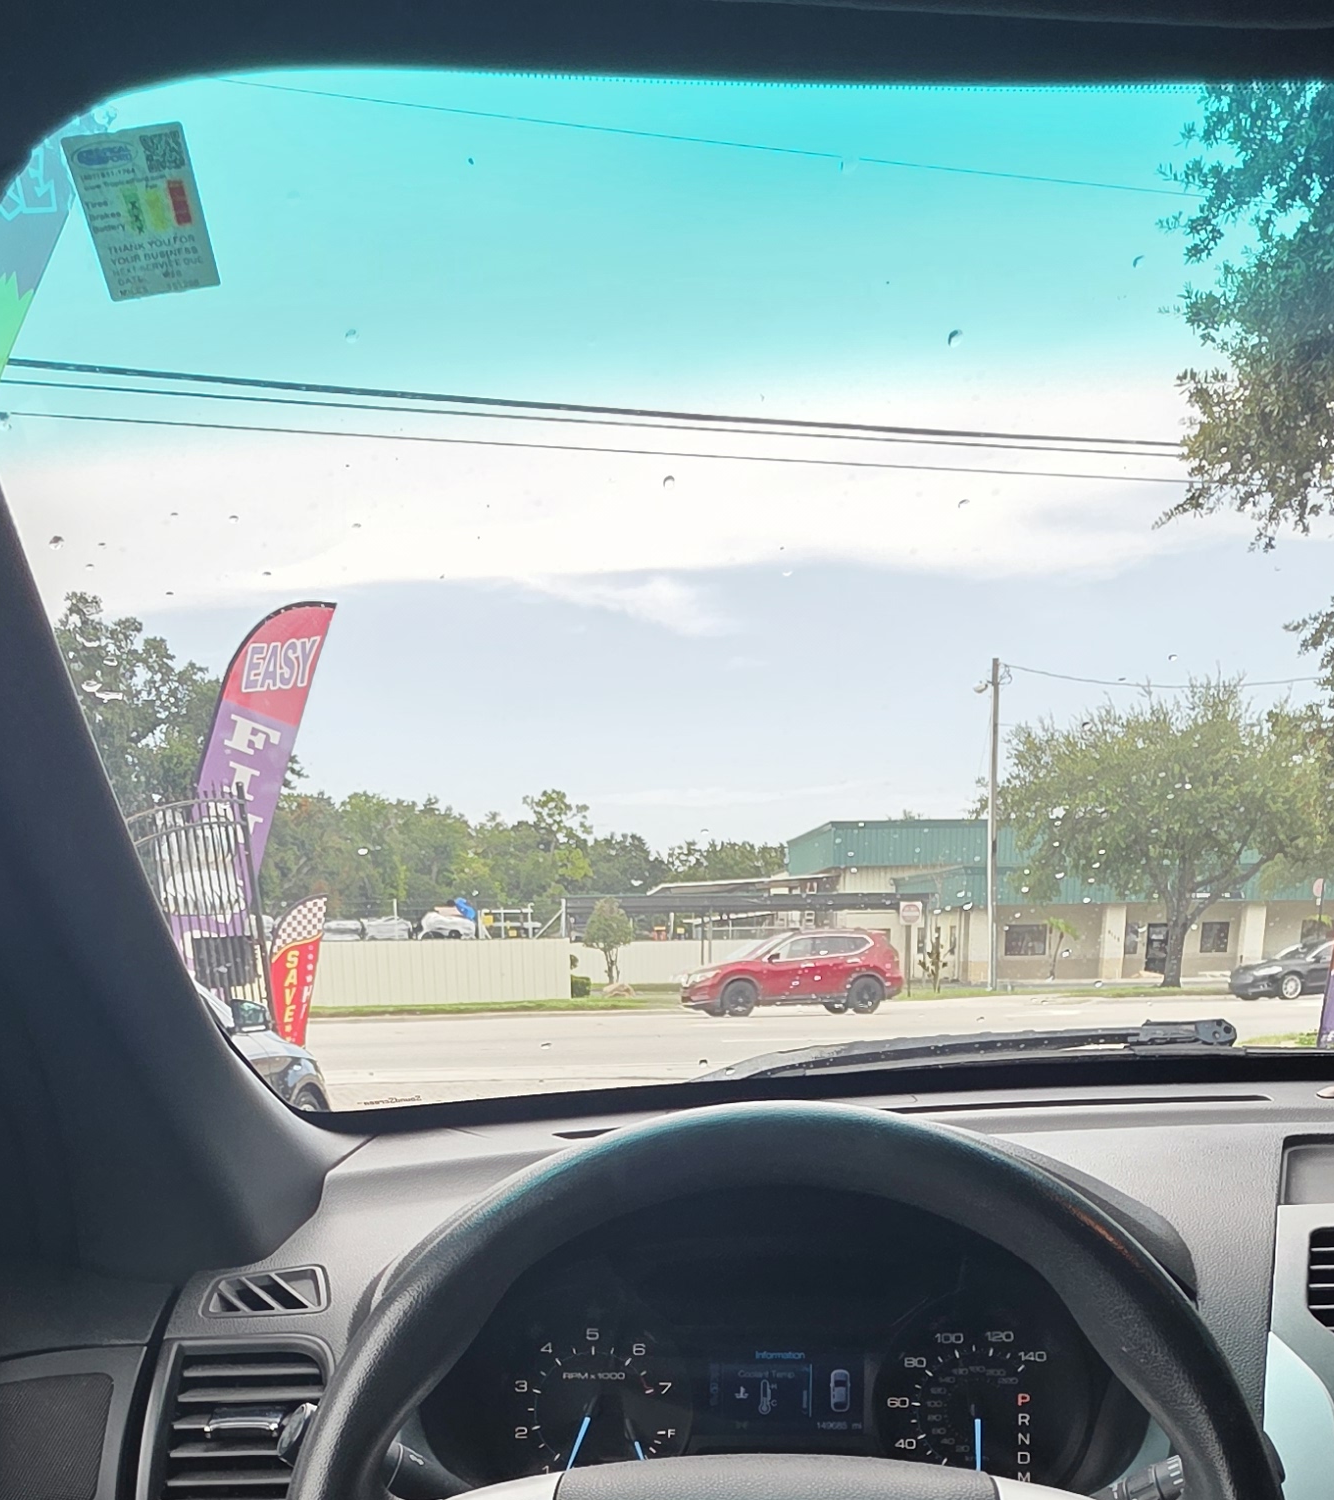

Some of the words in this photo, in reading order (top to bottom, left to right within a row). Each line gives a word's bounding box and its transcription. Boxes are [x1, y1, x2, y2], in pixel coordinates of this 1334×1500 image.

[89, 211, 122, 222] Brakes
[108, 243, 146, 255] THANK
[148, 237, 171, 249] YOU
[172, 234, 196, 245] FOR
[111, 252, 143, 266] YOUR
[144, 245, 199, 261] BUSINESS
[241, 636, 321, 694] EASY
[283, 950, 300, 1023] SAVE
[585, 1327, 600, 1341] 5
[935, 1332, 964, 1344] 100
[985, 1330, 1015, 1342] 120
[540, 1342, 553, 1354] 4
[632, 1343, 646, 1356] 6
[755, 1350, 806, 1360] Information
[1018, 1351, 1047, 1362] 140
[904, 1357, 927, 1368] 80
[562, 1372, 589, 1380] RPM
[597, 1372, 626, 1380] 1000
[737, 1369, 769, 1378] Coolant
[771, 1369, 795, 1379] Temp
[514, 1380, 528, 1393] 3
[658, 1382, 672, 1395] 7
[887, 1396, 910, 1408] 60
[1017, 1393, 1031, 1406] P
[1017, 1413, 1031, 1426] R
[514, 1426, 528, 1439] 2
[667, 1429, 676, 1438] F
[894, 1438, 917, 1450] 40
[1018, 1433, 1031, 1446] N
[1017, 1451, 1031, 1464] D
[1017, 1472, 1031, 1483] M
